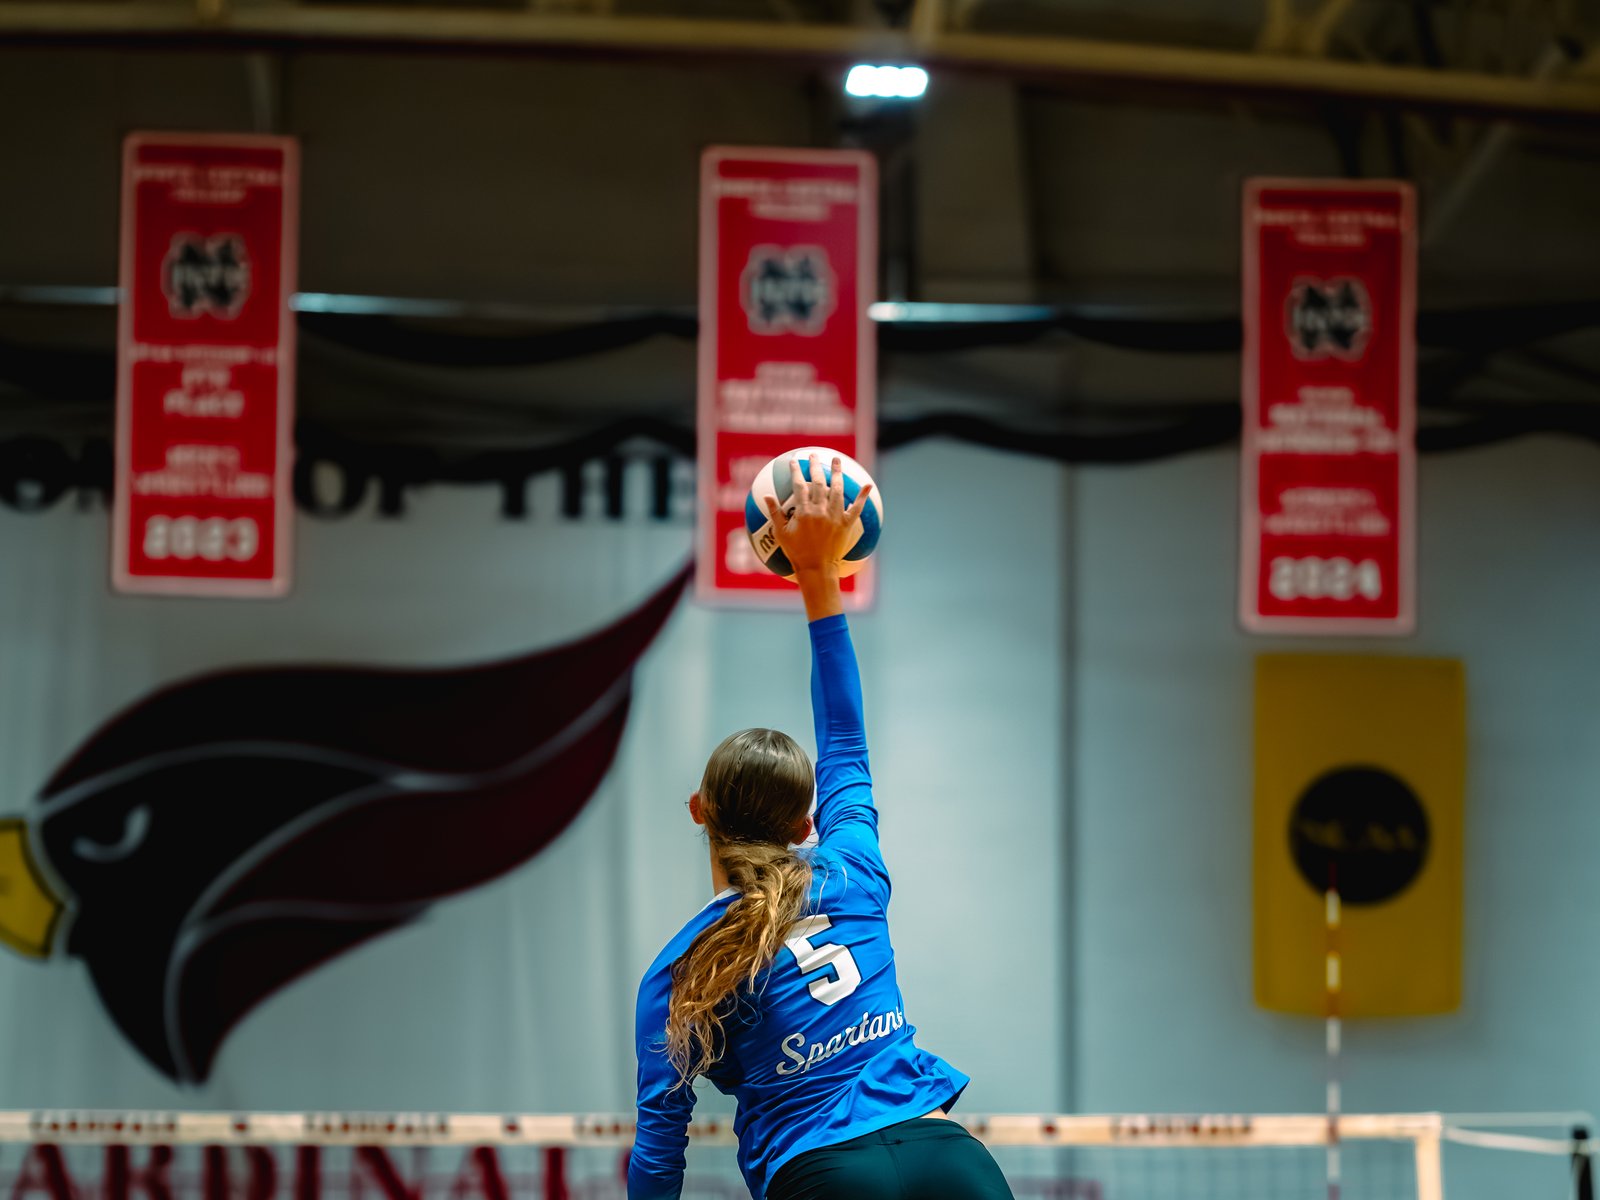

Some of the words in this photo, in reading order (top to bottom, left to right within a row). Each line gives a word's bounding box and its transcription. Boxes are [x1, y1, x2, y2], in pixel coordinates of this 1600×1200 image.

[143, 514, 260, 561] 2023
[1269, 555, 1382, 601] 2024
[783, 913, 862, 1007] 5
